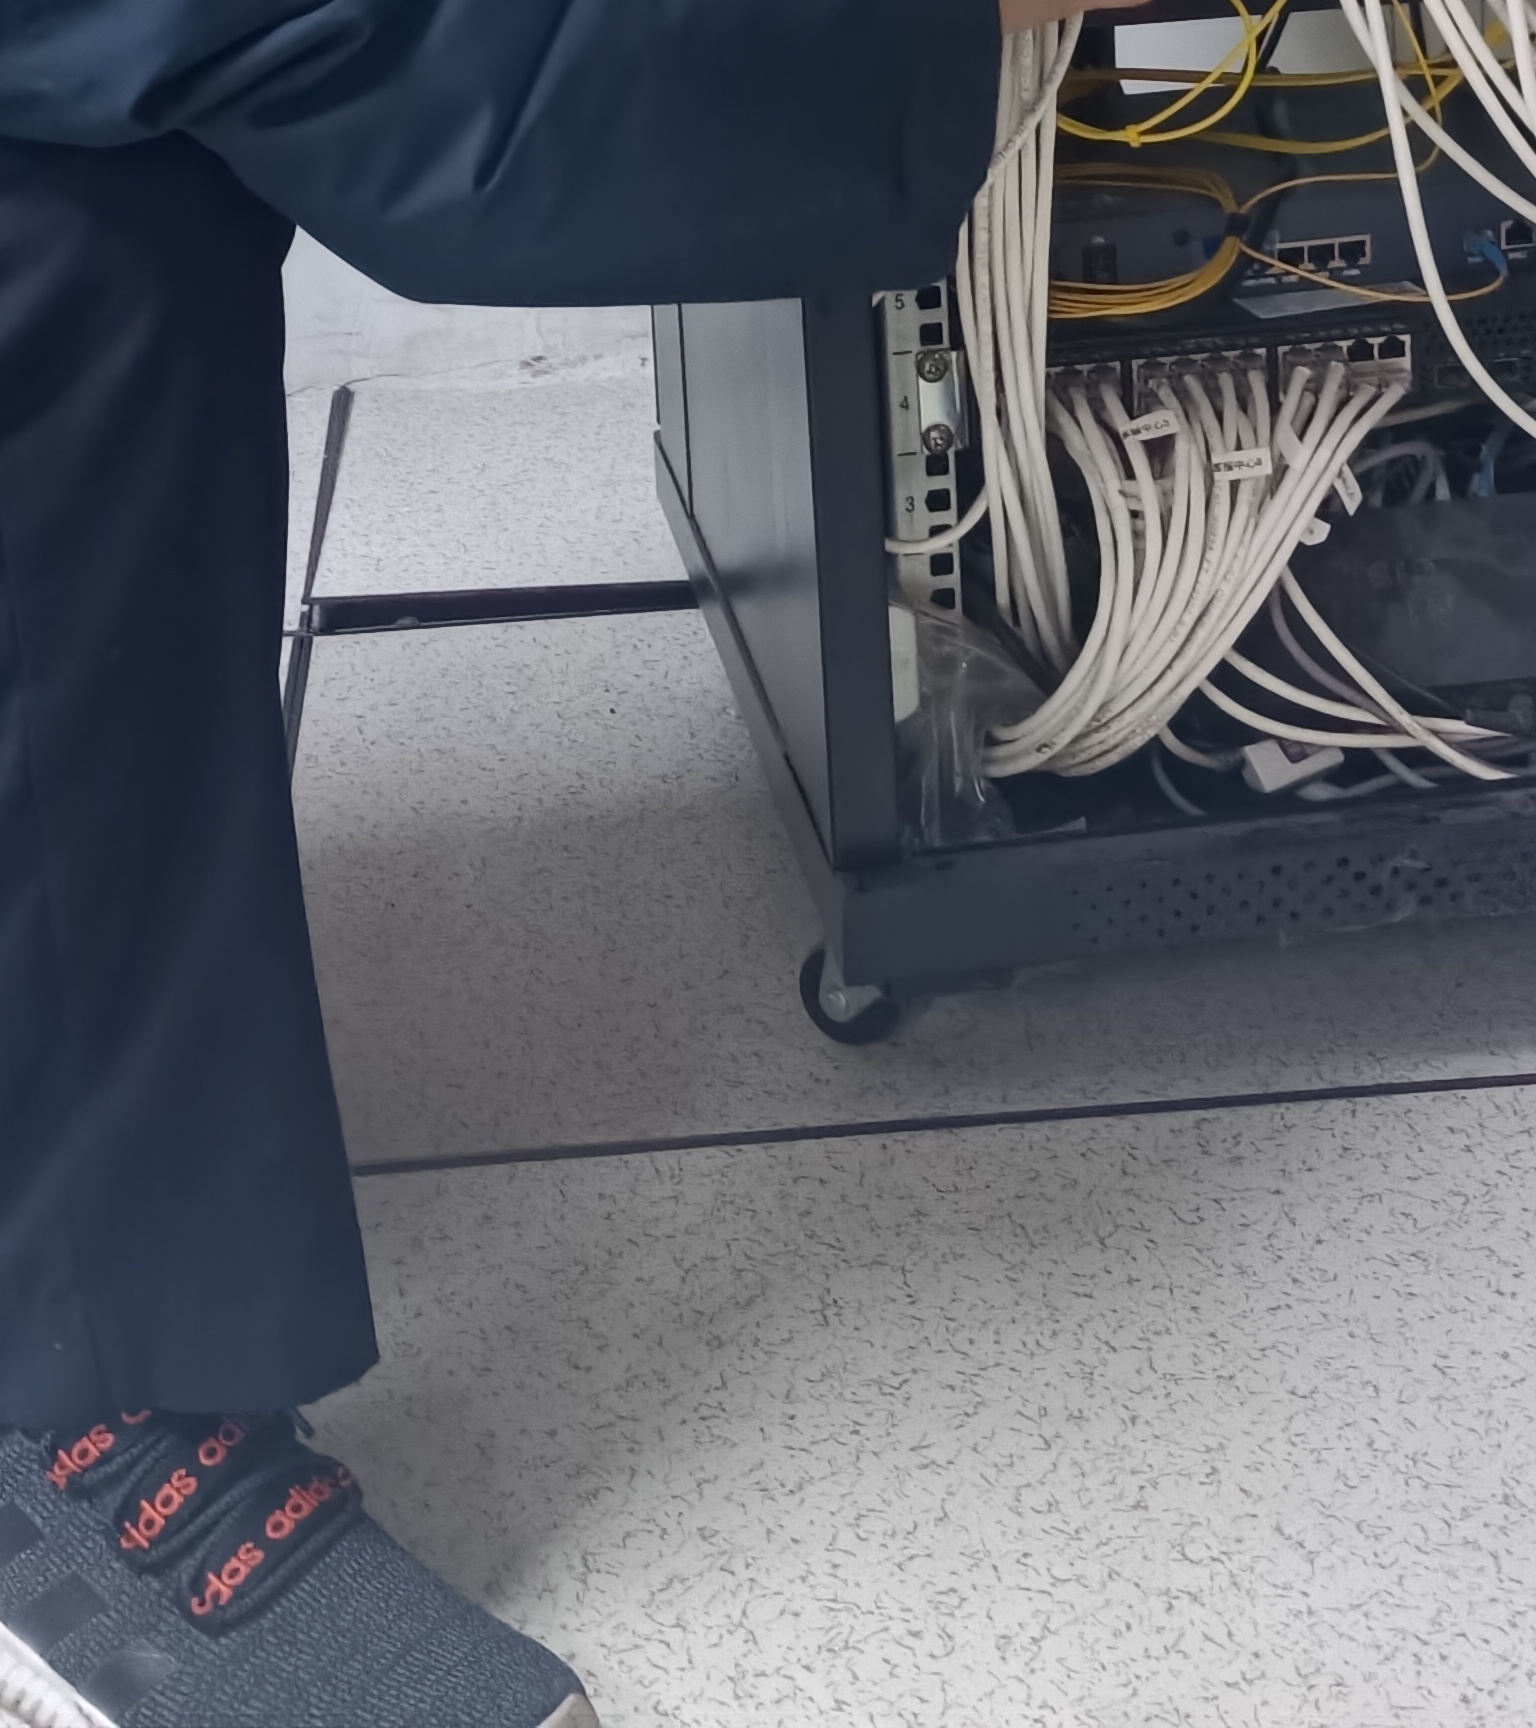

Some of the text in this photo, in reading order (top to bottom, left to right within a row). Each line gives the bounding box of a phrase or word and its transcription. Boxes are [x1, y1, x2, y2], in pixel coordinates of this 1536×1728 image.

[894, 293, 906, 310] 5
[899, 394, 911, 411] 4
[904, 496, 916, 514] 3
